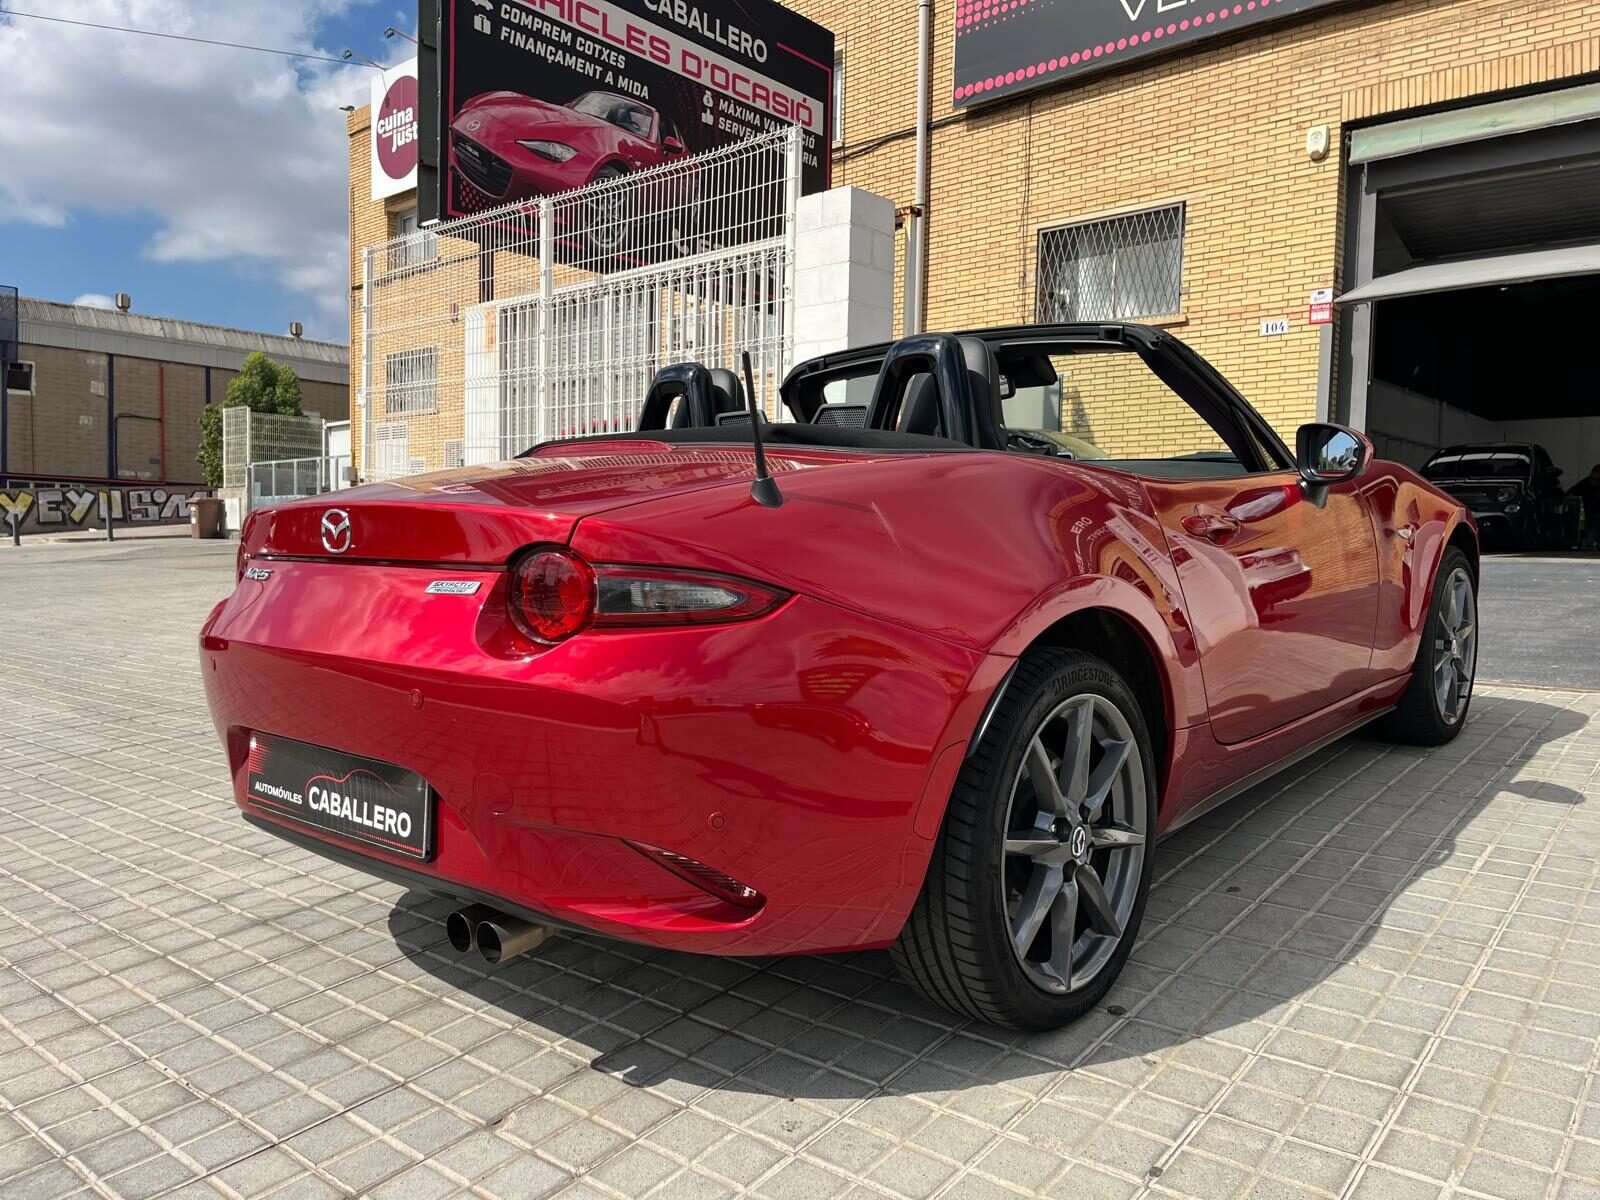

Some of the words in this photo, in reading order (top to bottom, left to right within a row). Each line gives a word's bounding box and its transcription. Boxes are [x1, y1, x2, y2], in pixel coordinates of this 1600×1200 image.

[500, 4, 572, 46] COMPREM
[576, 37, 626, 69] COTXES
[500, 26, 603, 80] FINANÇAMENT
[604, 71, 614, 85] A
[617, 73, 649, 99] MIDA
[518, 0, 671, 65] HICLES
[681, 48, 813, 128] D'OCASIÓ
[377, 107, 413, 135] cuina
[719, 98, 760, 127] MÀXIMA
[1265, 321, 1285, 333] 104
[254, 781, 302, 805] AUTOMÓVILES
[308, 786, 412, 838] CABALLERO
